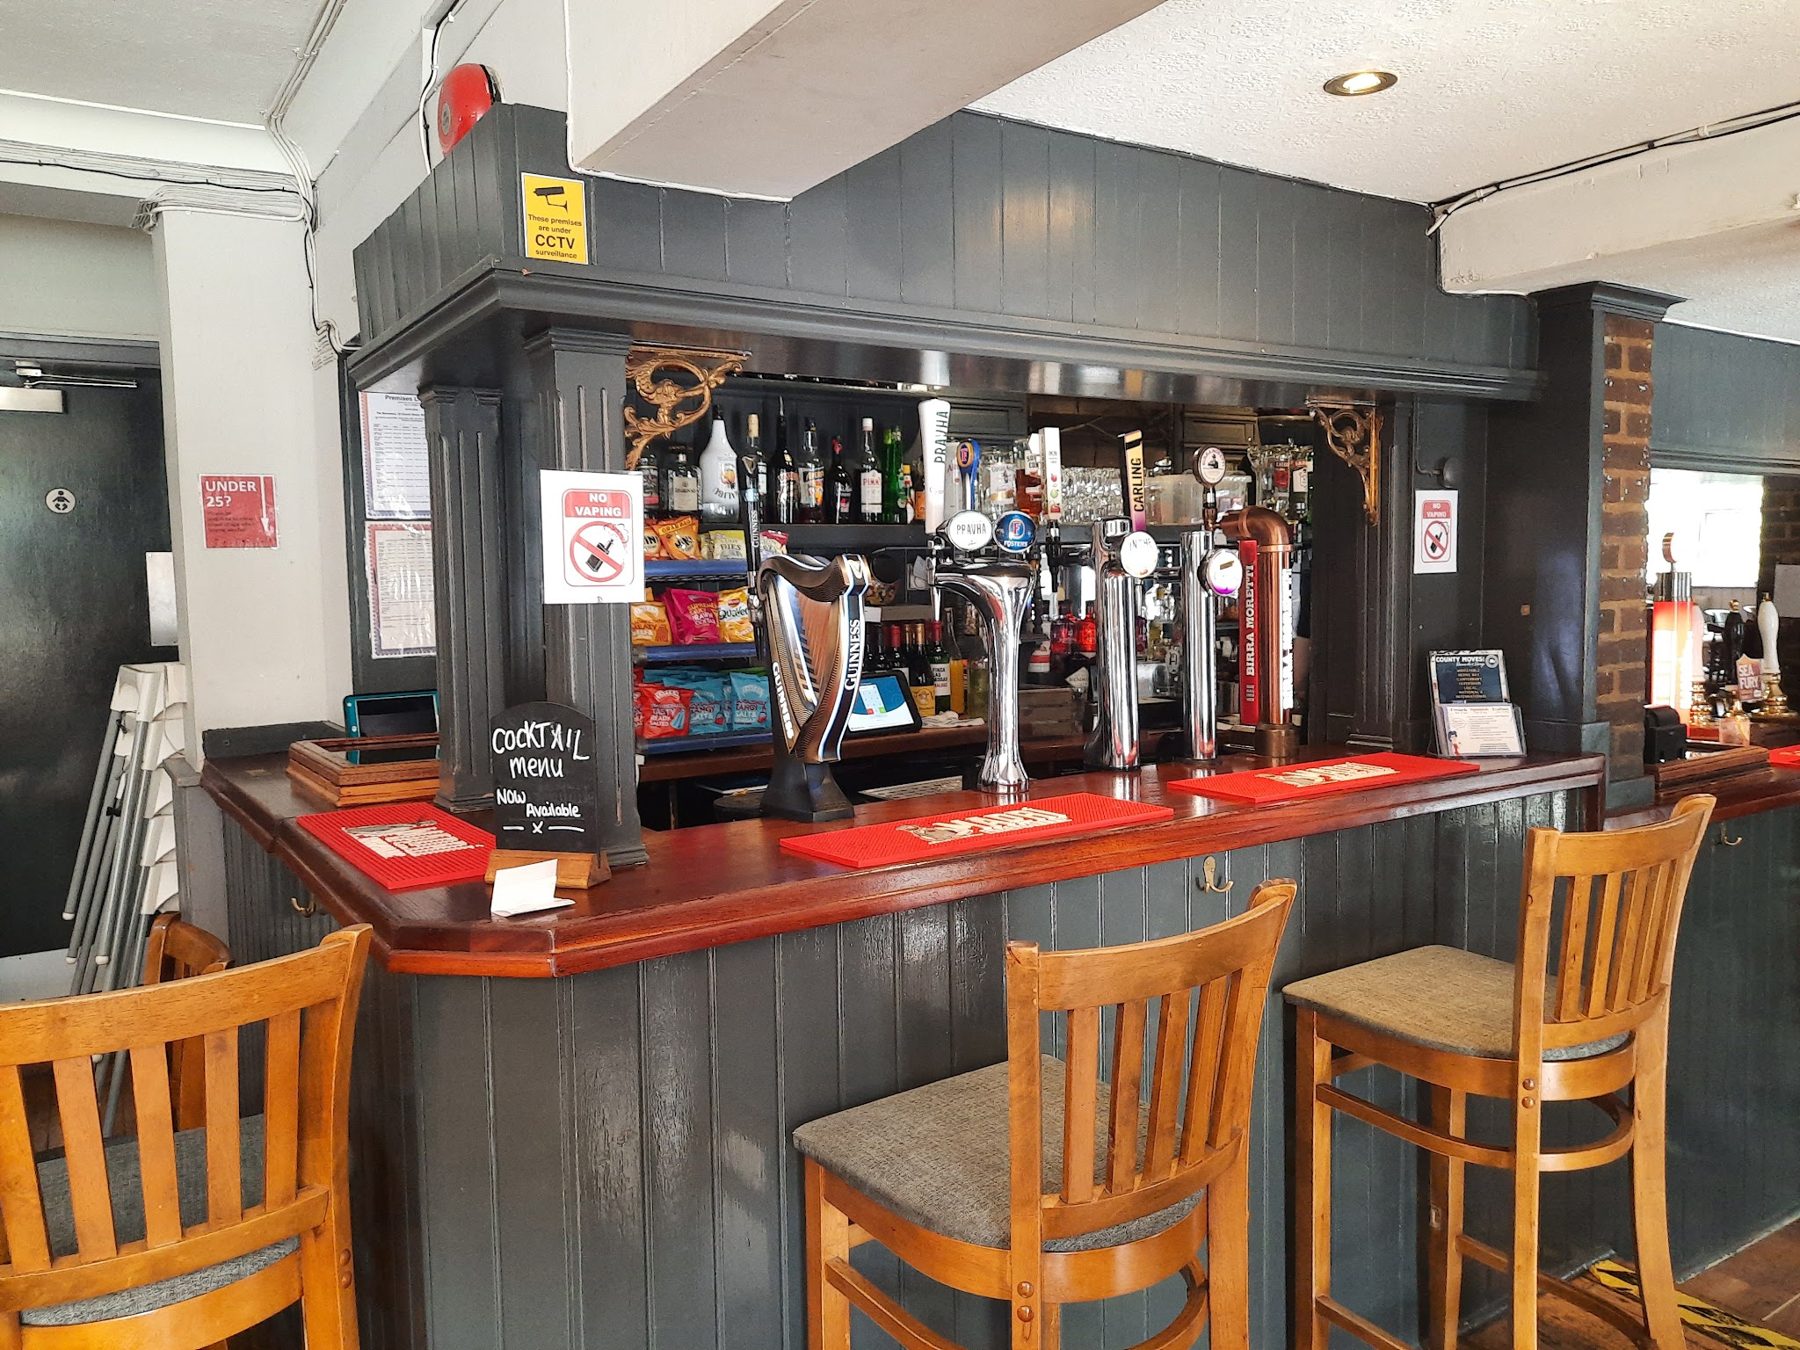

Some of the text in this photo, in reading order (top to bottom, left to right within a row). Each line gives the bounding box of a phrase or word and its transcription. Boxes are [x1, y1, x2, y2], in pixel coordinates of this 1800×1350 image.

[528, 213, 582, 227] These premises
[551, 226, 572, 234] under
[535, 234, 575, 250] CCTV
[535, 249, 578, 259] surveillance
[933, 410, 949, 464] PRAVHA
[205, 480, 257, 492] UNDER
[1130, 457, 1144, 512] CARLING
[206, 495, 232, 507] 25?
[589, 492, 608, 503] NO
[574, 506, 622, 517] VAPING
[751, 509, 760, 548] GUINNESS
[1245, 565, 1256, 677] BIRRA MORETTI
[844, 619, 861, 691] GUINNESS
[1738, 664, 1754, 677] SEA
[1740, 675, 1760, 690] FURY
[772, 662, 795, 740] GUINNESS
[526, 801, 581, 818] Available
